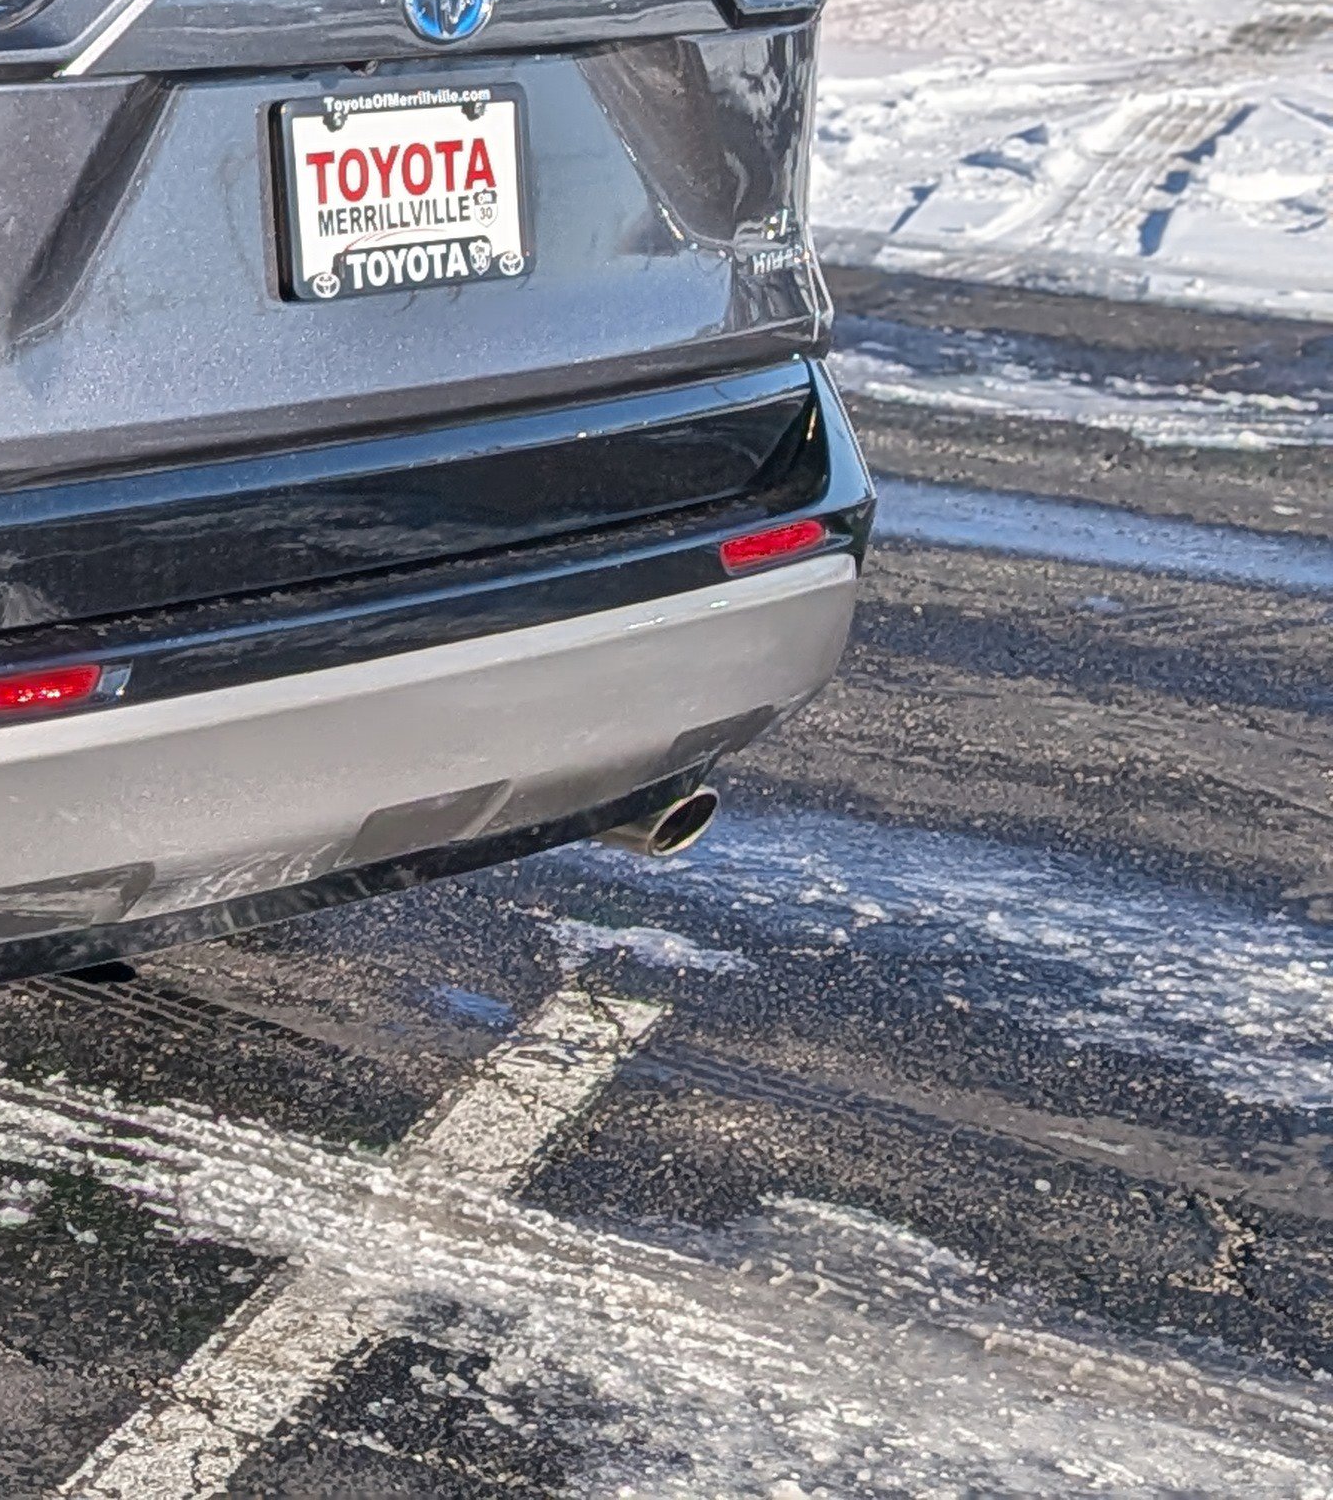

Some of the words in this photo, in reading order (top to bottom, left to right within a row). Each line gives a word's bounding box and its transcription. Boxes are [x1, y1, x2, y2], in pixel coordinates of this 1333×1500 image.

[323, 88, 492, 114] ToyotaOfMerrillville.com
[306, 138, 497, 205] TOYOTA
[318, 196, 472, 238] MERRILLVILLE
[346, 242, 470, 289] TOYOTA
